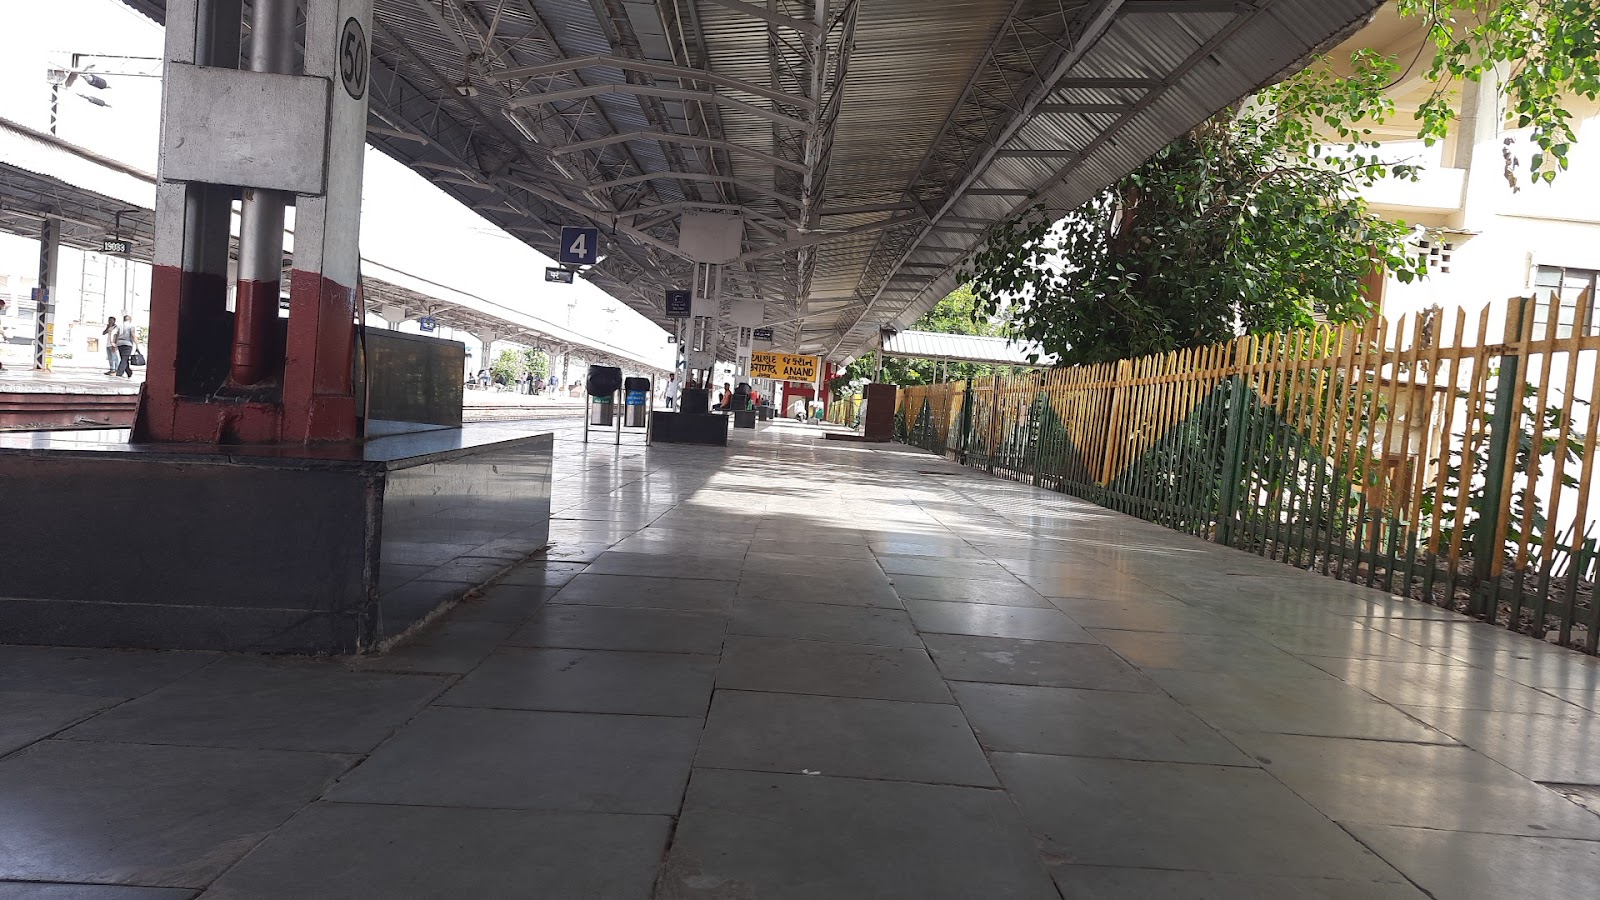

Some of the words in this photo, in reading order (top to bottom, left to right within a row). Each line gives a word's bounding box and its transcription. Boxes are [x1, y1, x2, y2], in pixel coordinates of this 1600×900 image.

[344, 31, 363, 89] 50
[569, 233, 588, 259] 4
[784, 367, 813, 376] ANAND
